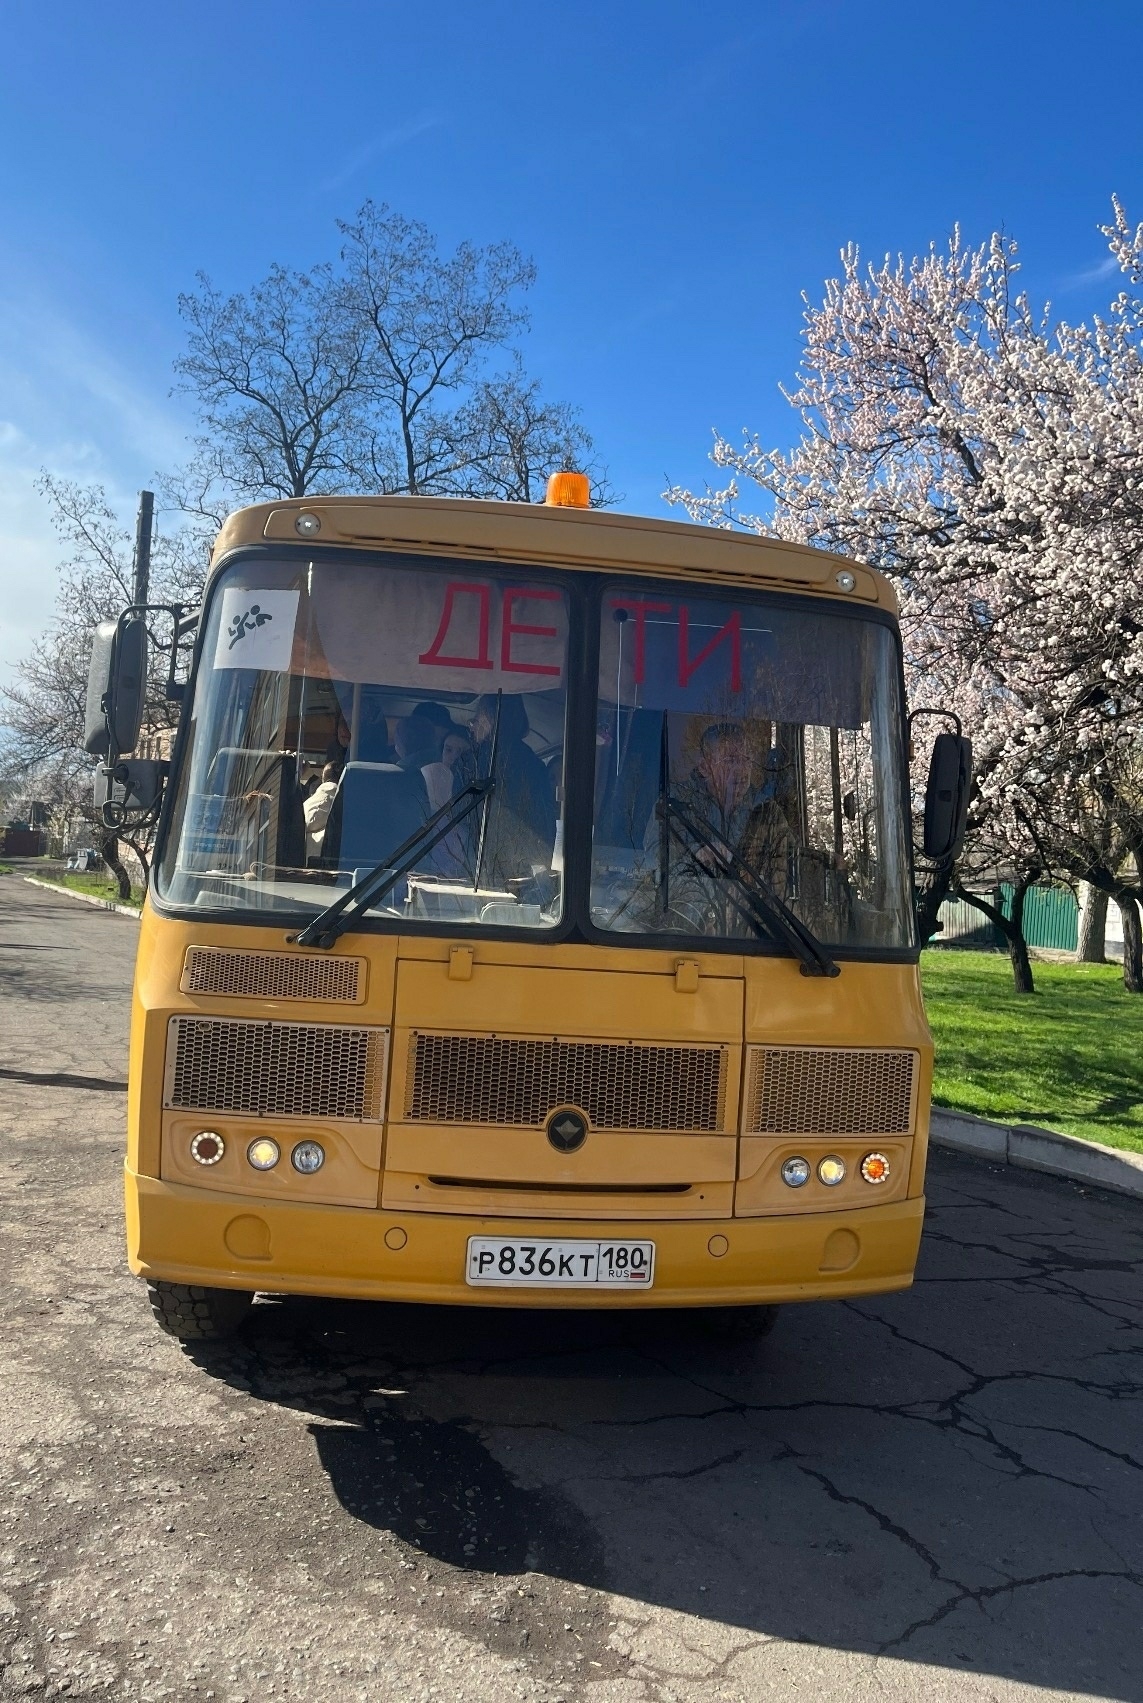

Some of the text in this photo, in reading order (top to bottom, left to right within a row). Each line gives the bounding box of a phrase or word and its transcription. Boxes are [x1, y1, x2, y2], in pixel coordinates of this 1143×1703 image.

[478, 1246, 644, 1276] Р836КТ 180
[608, 1269, 630, 1278] RUS
